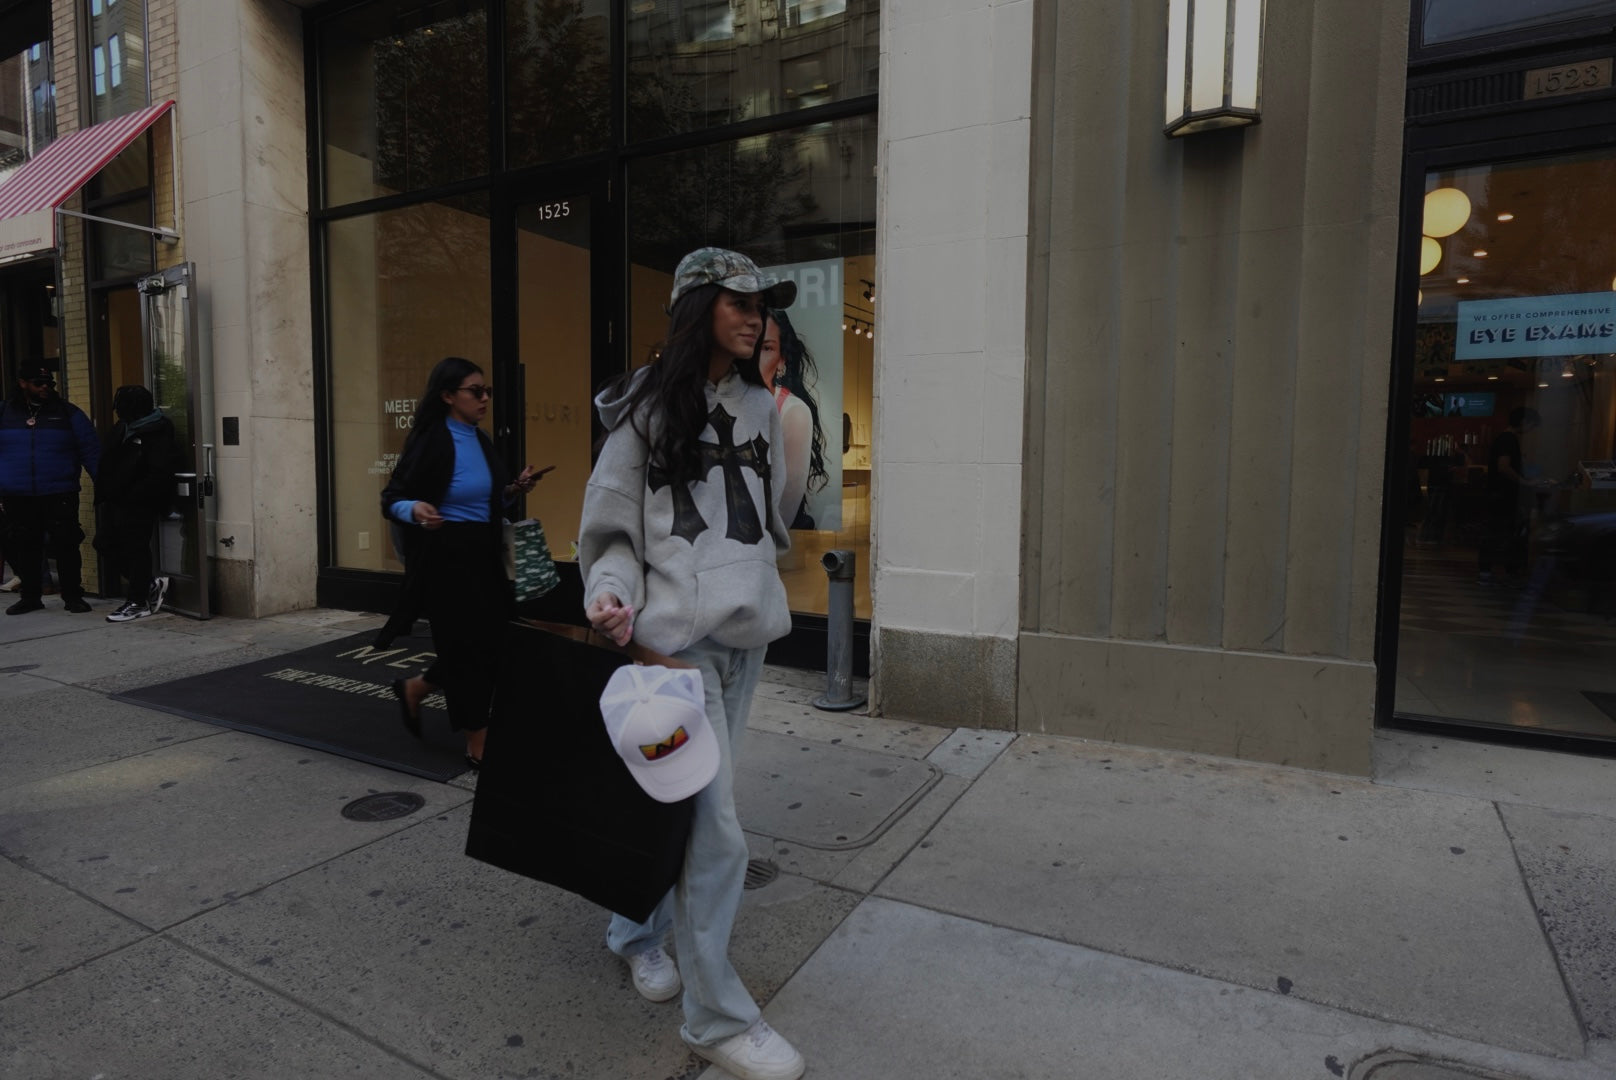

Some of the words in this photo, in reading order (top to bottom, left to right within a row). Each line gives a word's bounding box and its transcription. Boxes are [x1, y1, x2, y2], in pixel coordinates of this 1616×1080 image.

[1536, 65, 1600, 94] 1523
[538, 202, 570, 220] 1525
[1491, 313, 1521, 321] OFFER
[1525, 307, 1612, 319] COMPREHENSIVE
[1470, 328, 1517, 344] EYE
[1526, 321, 1616, 341] EXAMS
[384, 399, 418, 413] MEET
